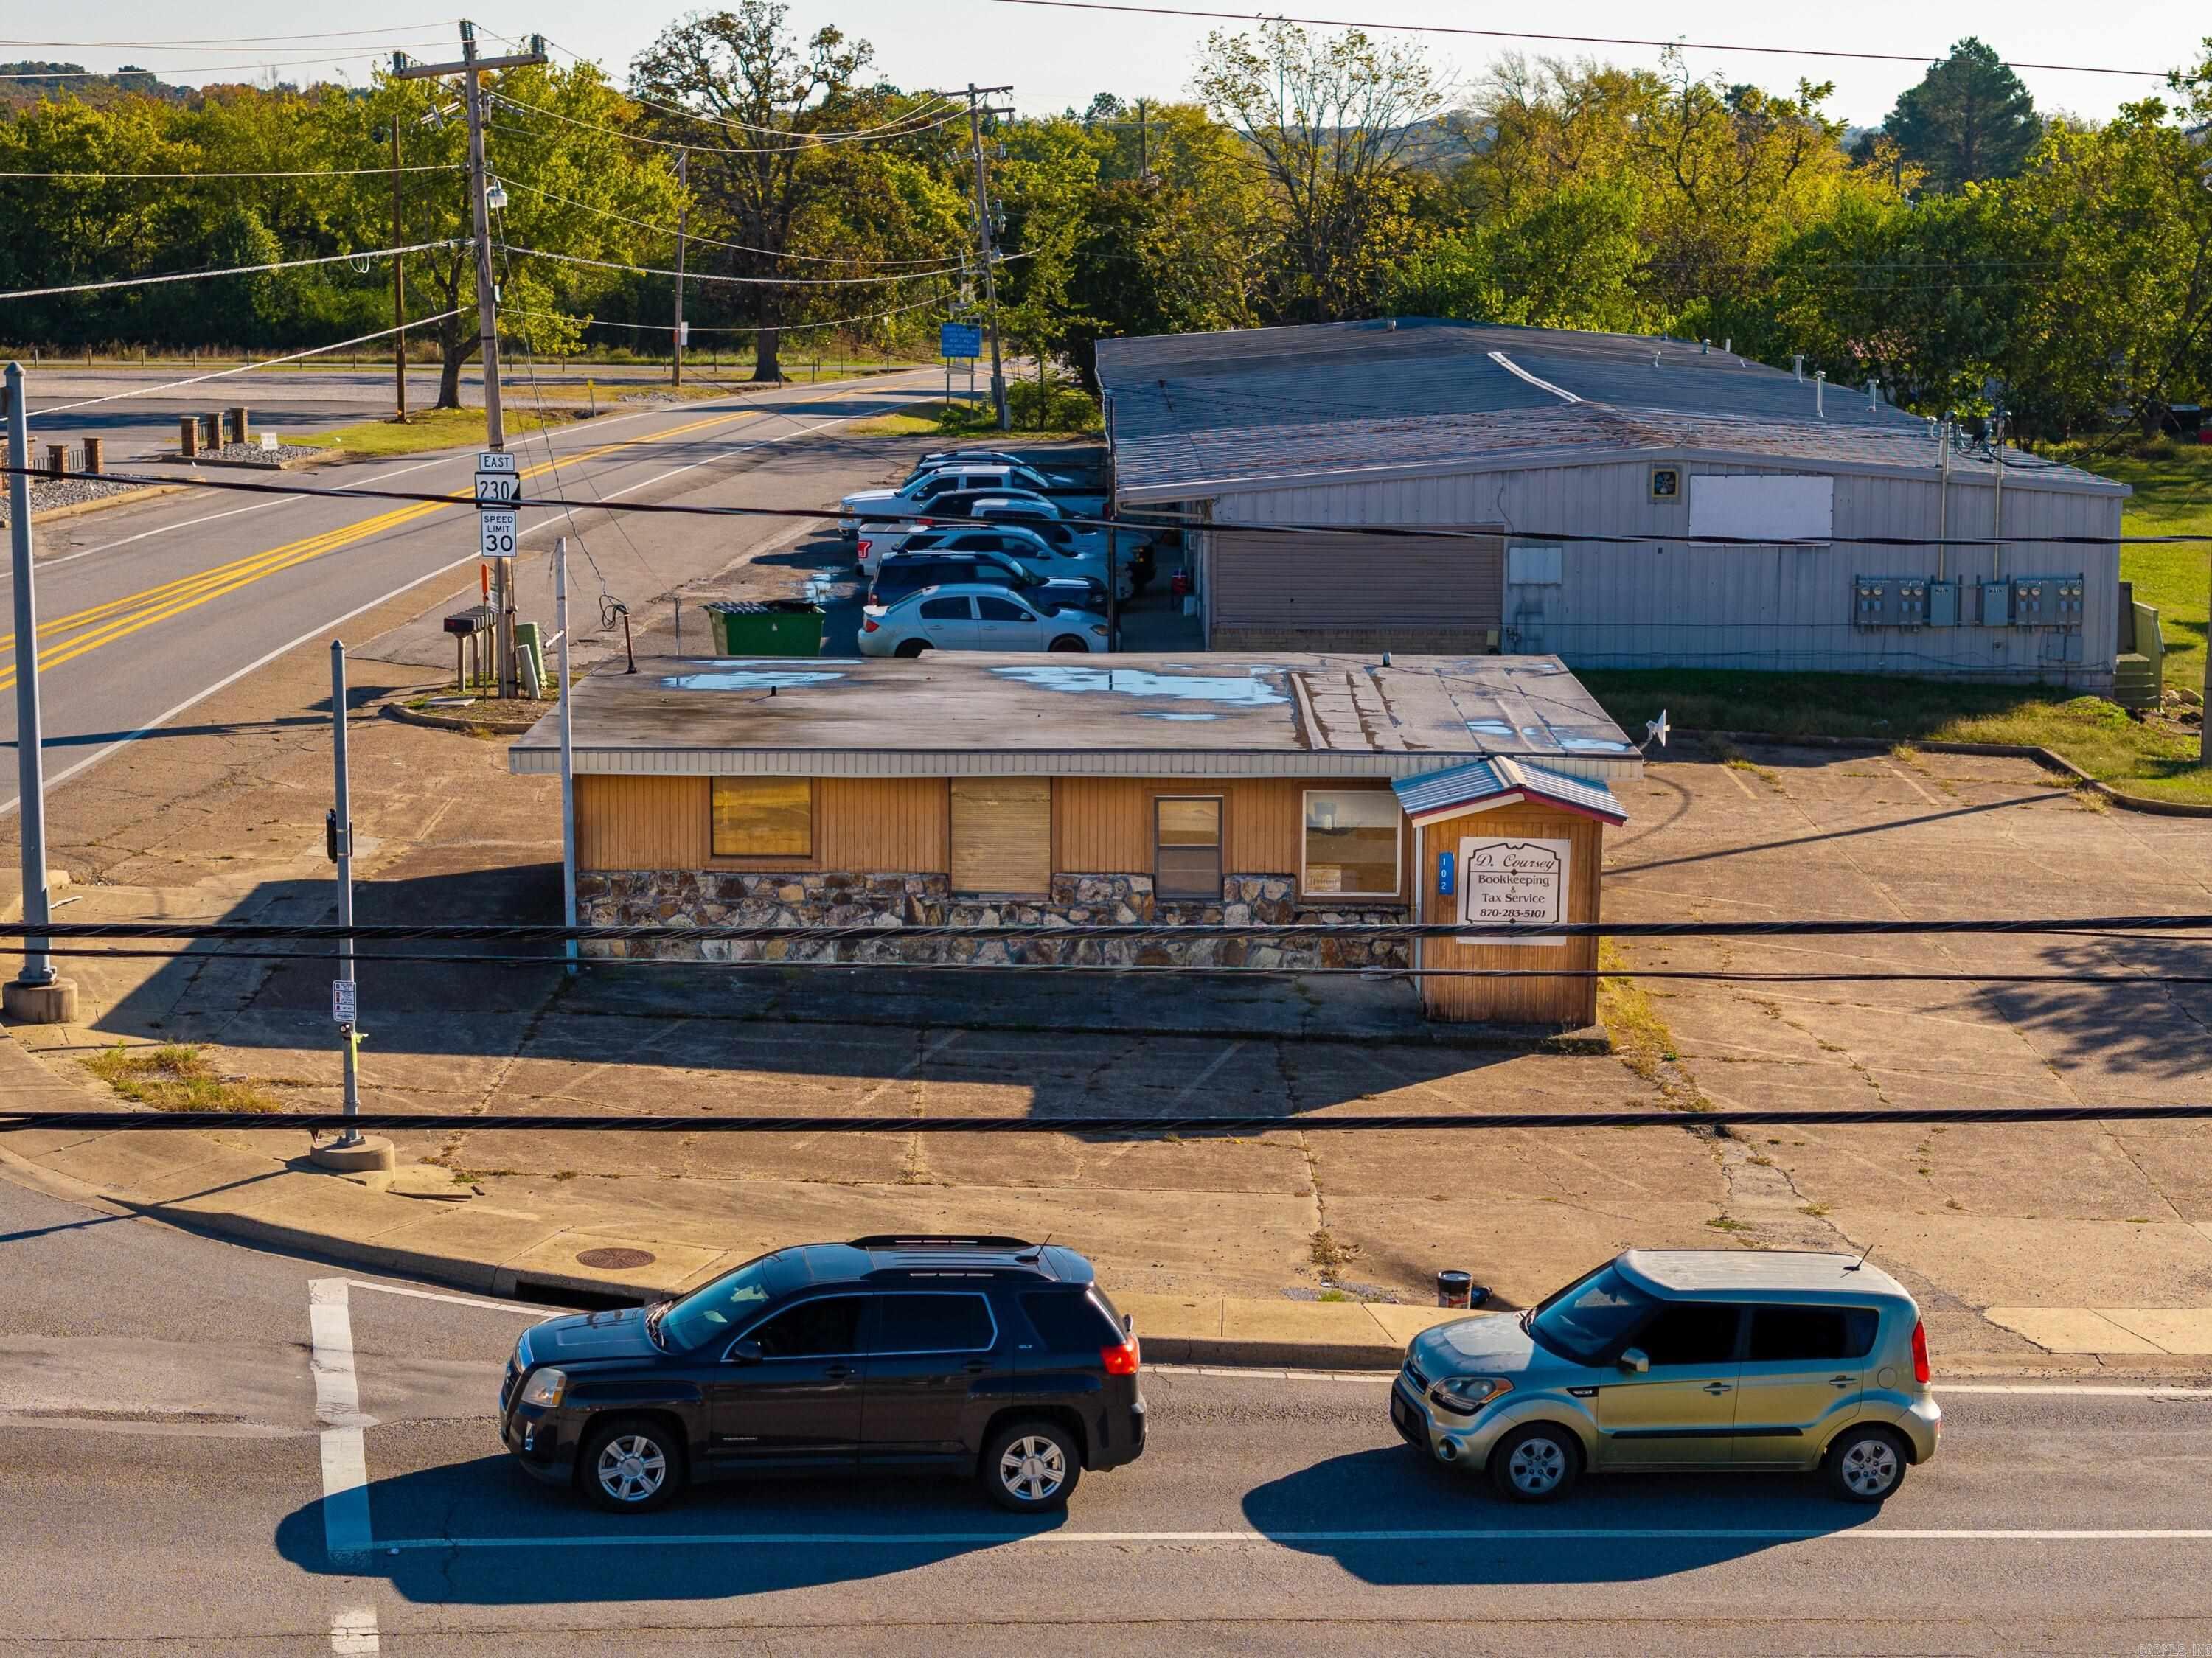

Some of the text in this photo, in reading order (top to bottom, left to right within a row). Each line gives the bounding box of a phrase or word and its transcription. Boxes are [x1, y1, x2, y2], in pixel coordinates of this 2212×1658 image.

[484, 456, 509, 467] EAST
[480, 481, 510, 501] 230
[484, 515, 513, 523] SPEED
[485, 534, 513, 552] 30
[1475, 853, 1555, 871] D. Coursey
[1478, 874, 1550, 887] Bookkeeping
[1481, 894, 1545, 903] Tax Service
[1480, 908, 1545, 918] 870-283-5101
